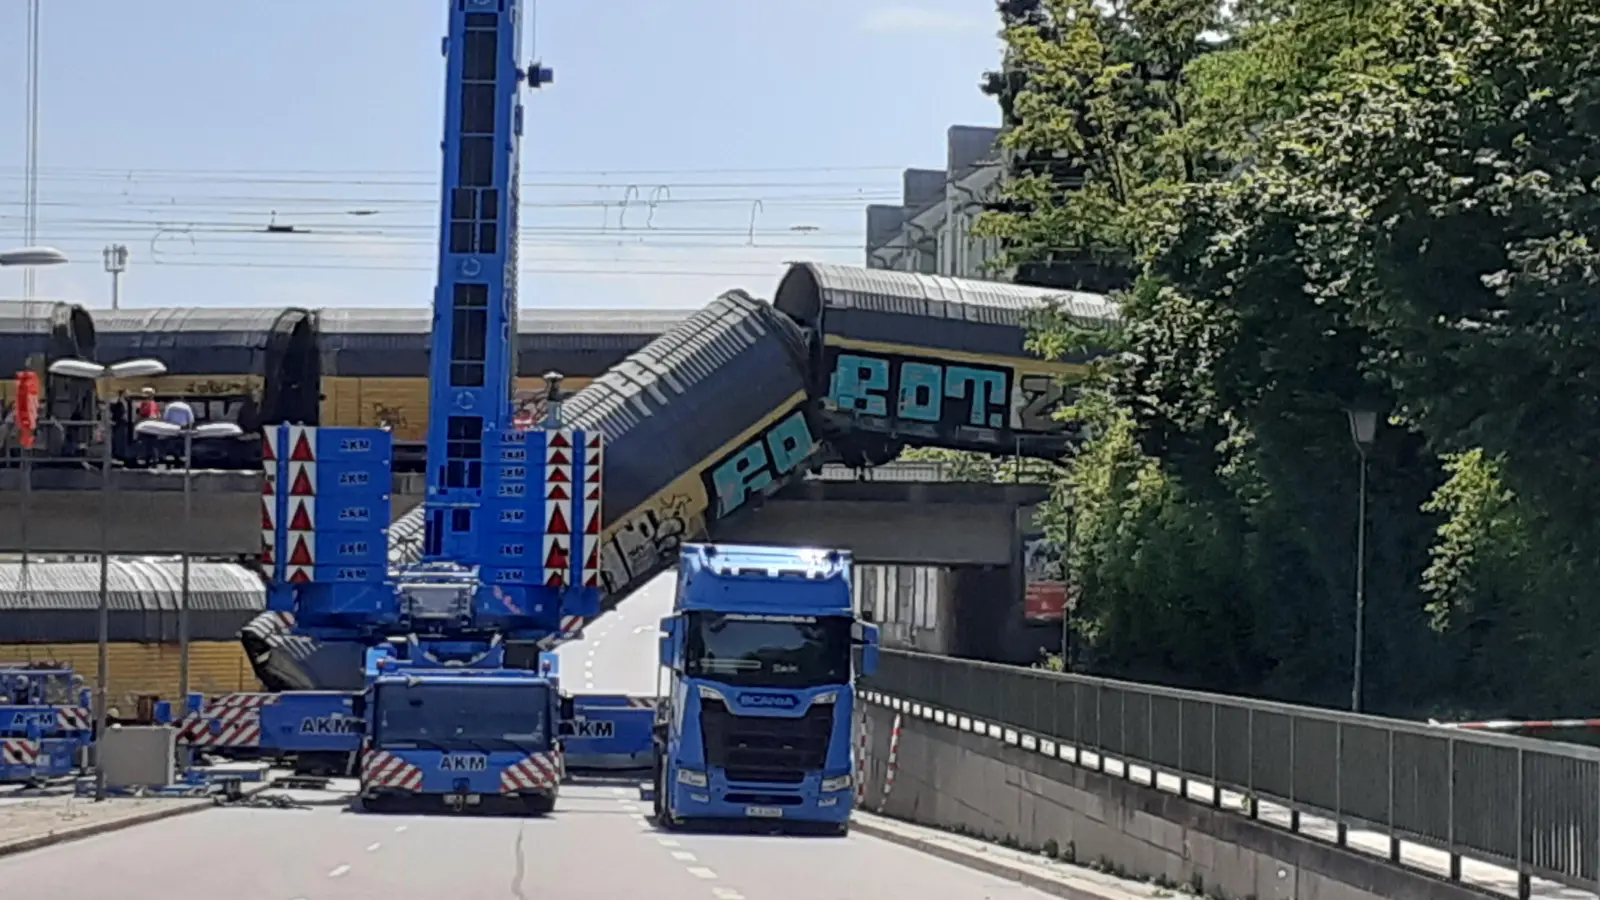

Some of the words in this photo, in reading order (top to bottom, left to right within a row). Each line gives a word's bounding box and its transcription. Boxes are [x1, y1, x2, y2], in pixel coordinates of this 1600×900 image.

[339, 439, 370, 451] AKM
[338, 472, 369, 484] AKM
[338, 508, 370, 520] AKM
[338, 543, 368, 555] AKM
[337, 568, 367, 580] AKM
[740, 694, 794, 707] SCANIA
[12, 712, 54, 726] AM
[299, 717, 355, 733] AKM
[438, 754, 487, 771] AKM
